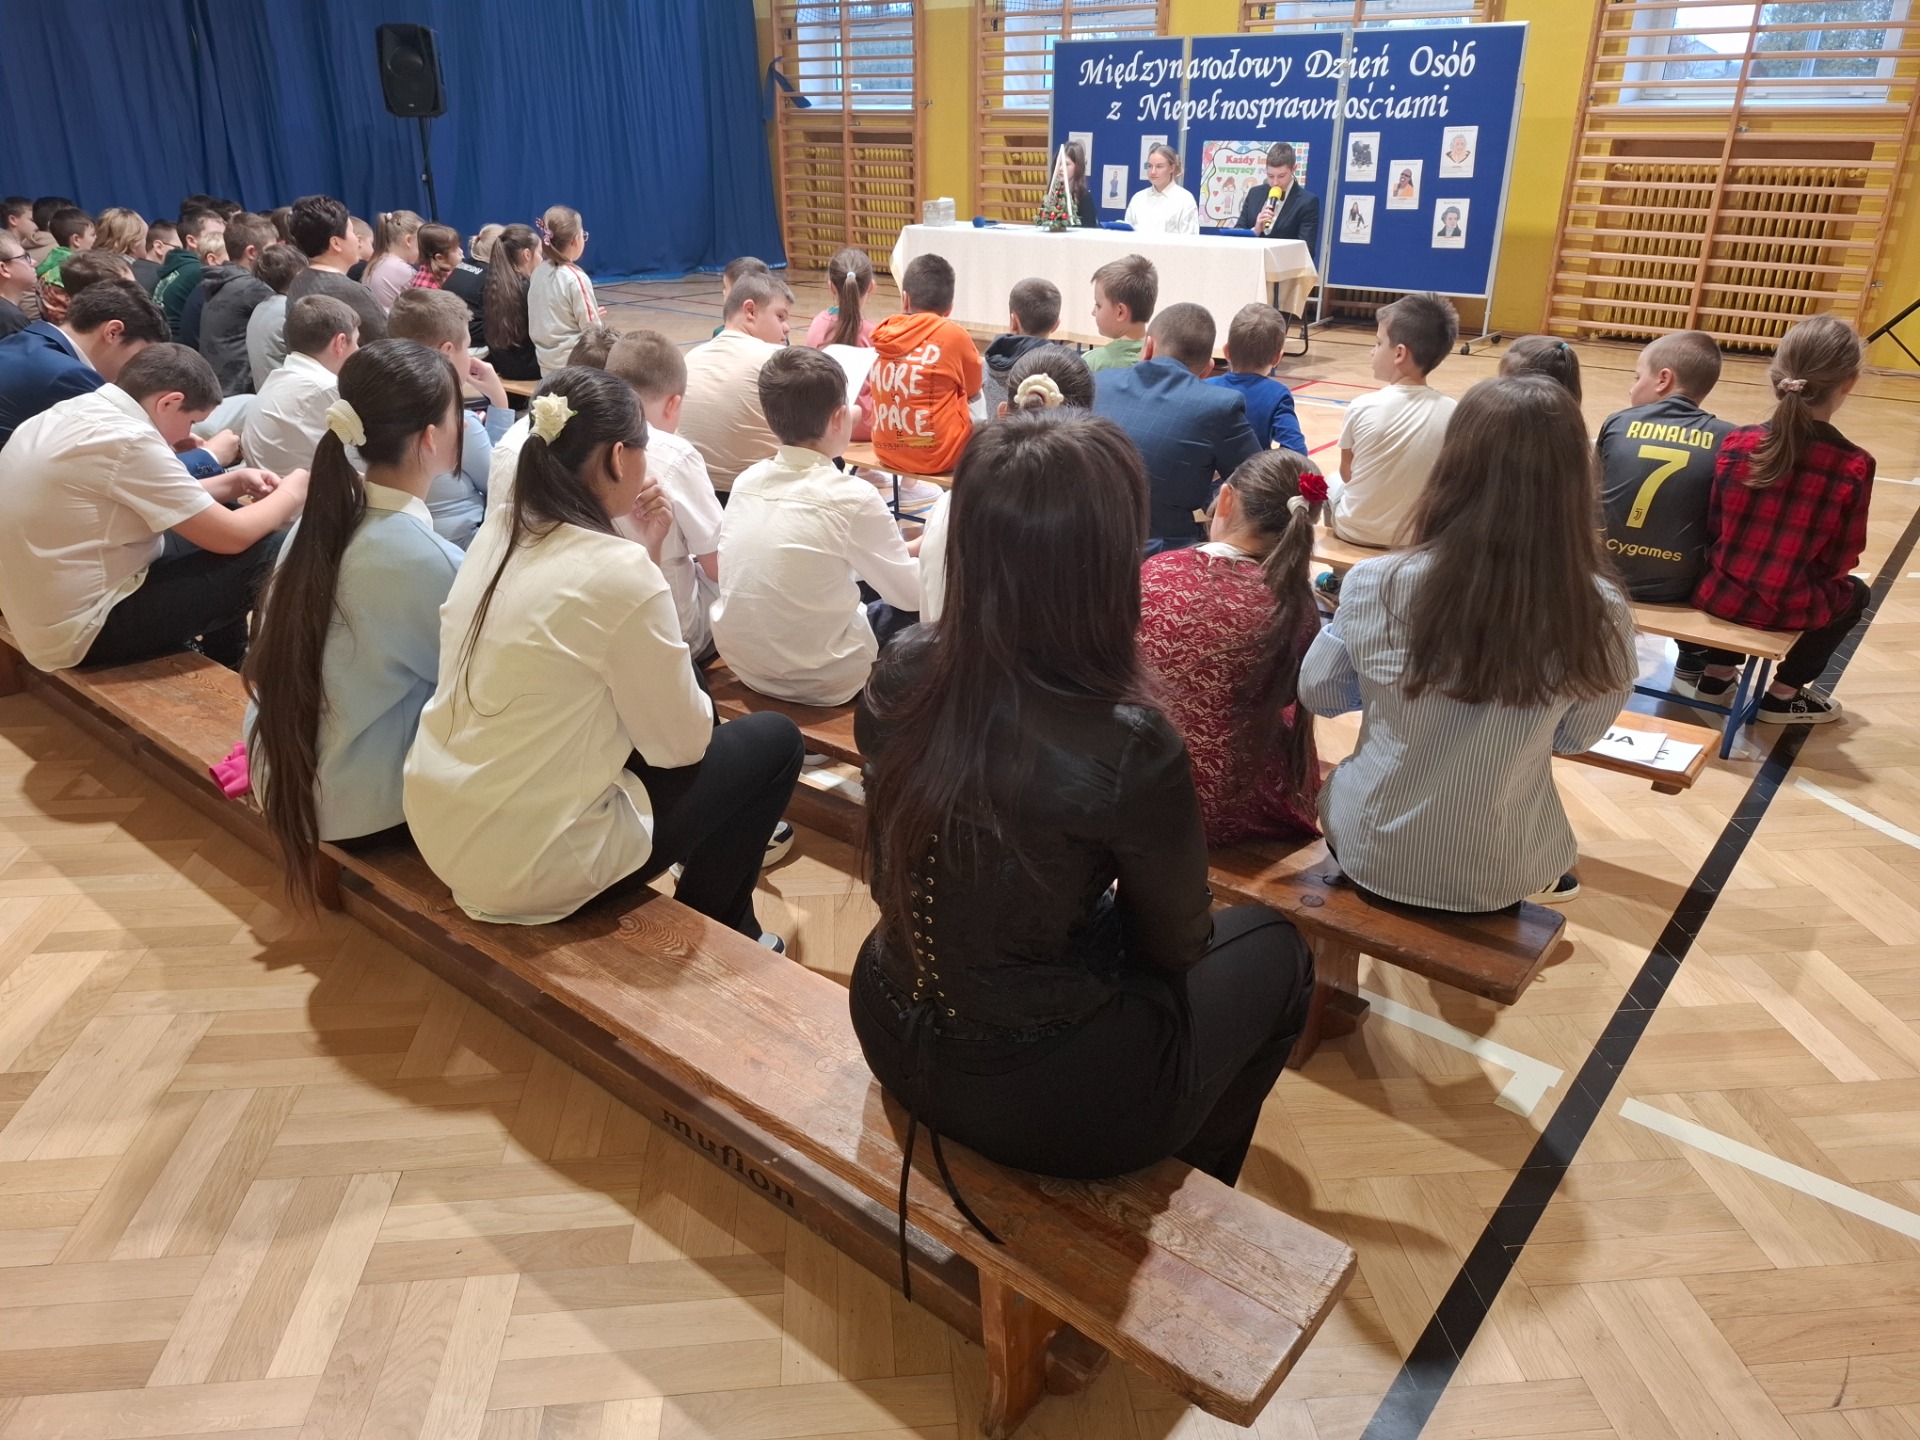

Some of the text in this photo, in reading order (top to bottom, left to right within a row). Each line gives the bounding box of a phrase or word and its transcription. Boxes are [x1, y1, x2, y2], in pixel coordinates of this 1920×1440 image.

[1078, 40, 1477, 90] Międzynarodowy Dzień Osób
[1106, 81, 1450, 131] z Niepełnosprawnościami
[870, 360, 925, 398] MORE
[1626, 421, 1714, 450] RONALDO
[1625, 444, 1691, 529] 7
[1605, 538, 1683, 562] Cygames
[1602, 732, 1635, 746] JA
